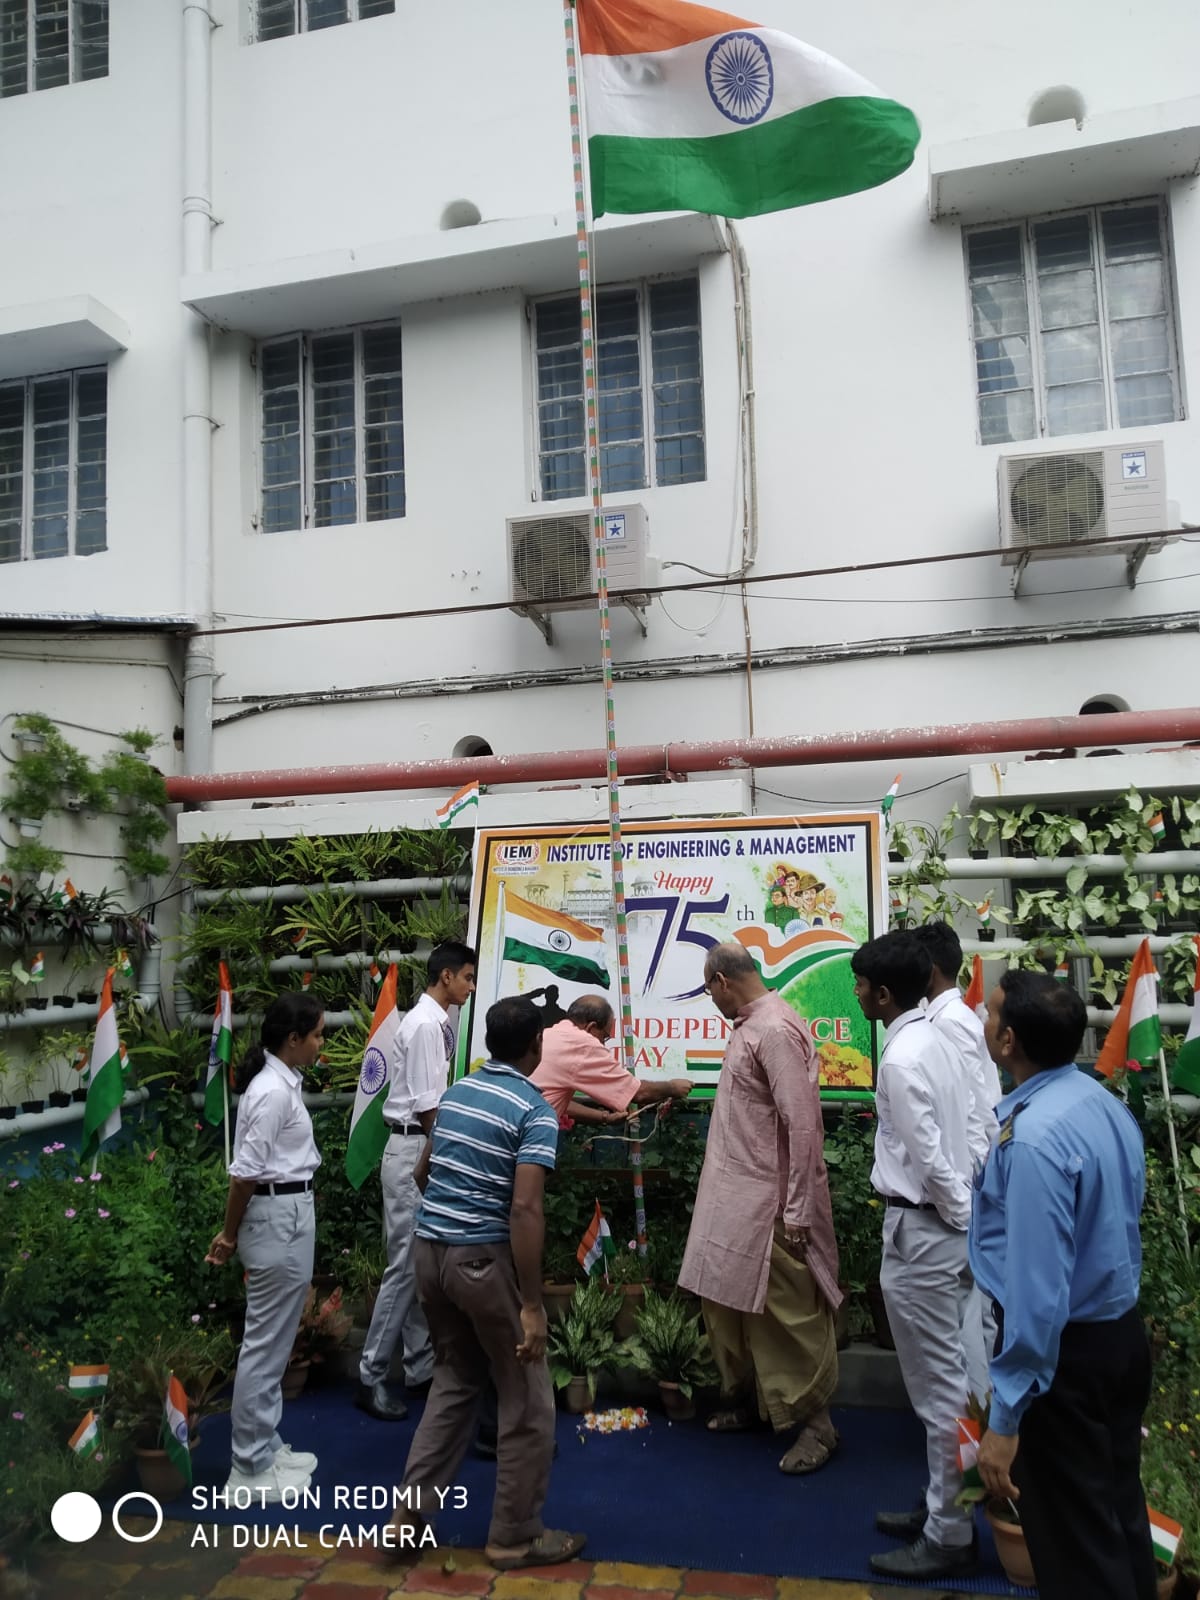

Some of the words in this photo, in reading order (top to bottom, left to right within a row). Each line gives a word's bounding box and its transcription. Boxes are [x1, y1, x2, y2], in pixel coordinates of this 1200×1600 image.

[504, 846, 532, 859] IEM
[547, 844, 611, 862] INSTITUTE
[638, 839, 731, 858] ENGINEERING
[736, 839, 745, 856] &
[750, 834, 855, 855] MANAGEMENT
[654, 870, 713, 895] Happy
[737, 905, 755, 921] th
[610, 1015, 851, 1041] INDEPENCE
